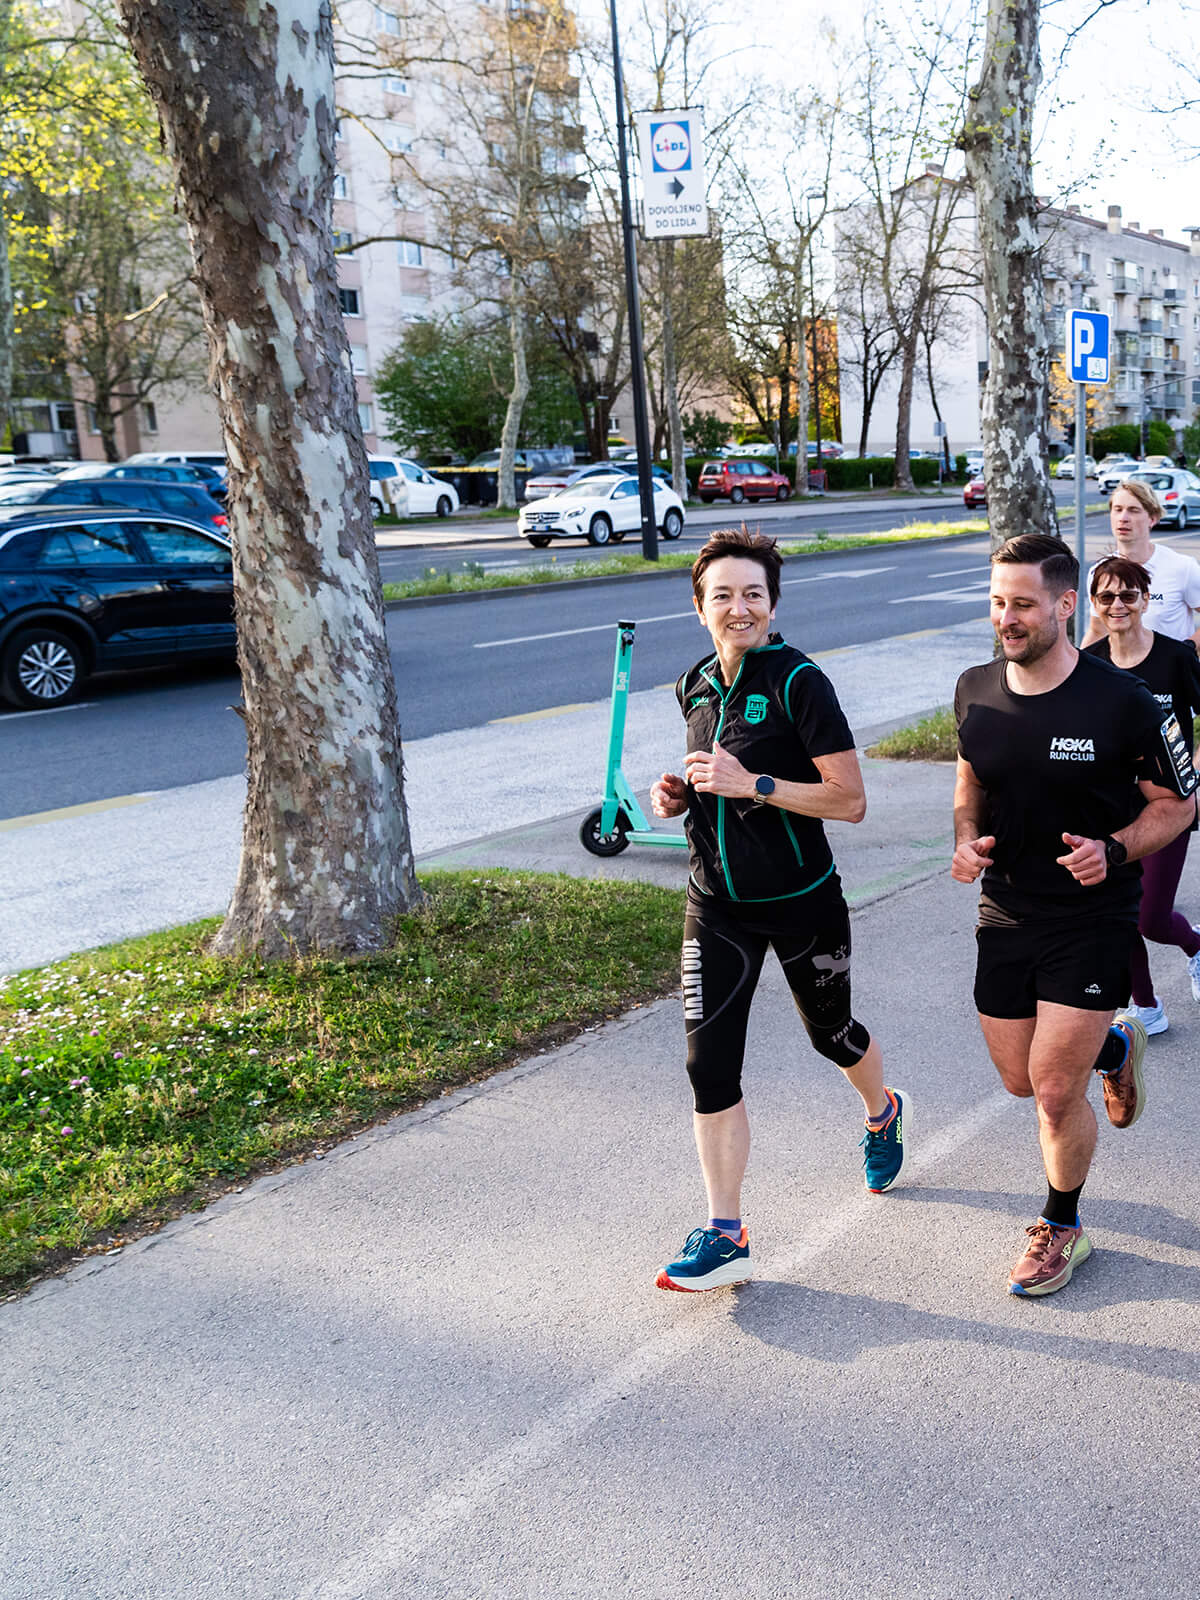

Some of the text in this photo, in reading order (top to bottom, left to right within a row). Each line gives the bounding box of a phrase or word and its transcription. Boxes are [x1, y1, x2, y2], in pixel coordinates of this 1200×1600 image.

[649, 204, 702, 215] DOVOLJENO
[656, 218, 696, 228] DO LIDLA
[1074, 318, 1095, 367] P
[1153, 694, 1172, 703] OKA
[1050, 737, 1095, 752] HOKA
[1050, 751, 1095, 761] RUN CLUB
